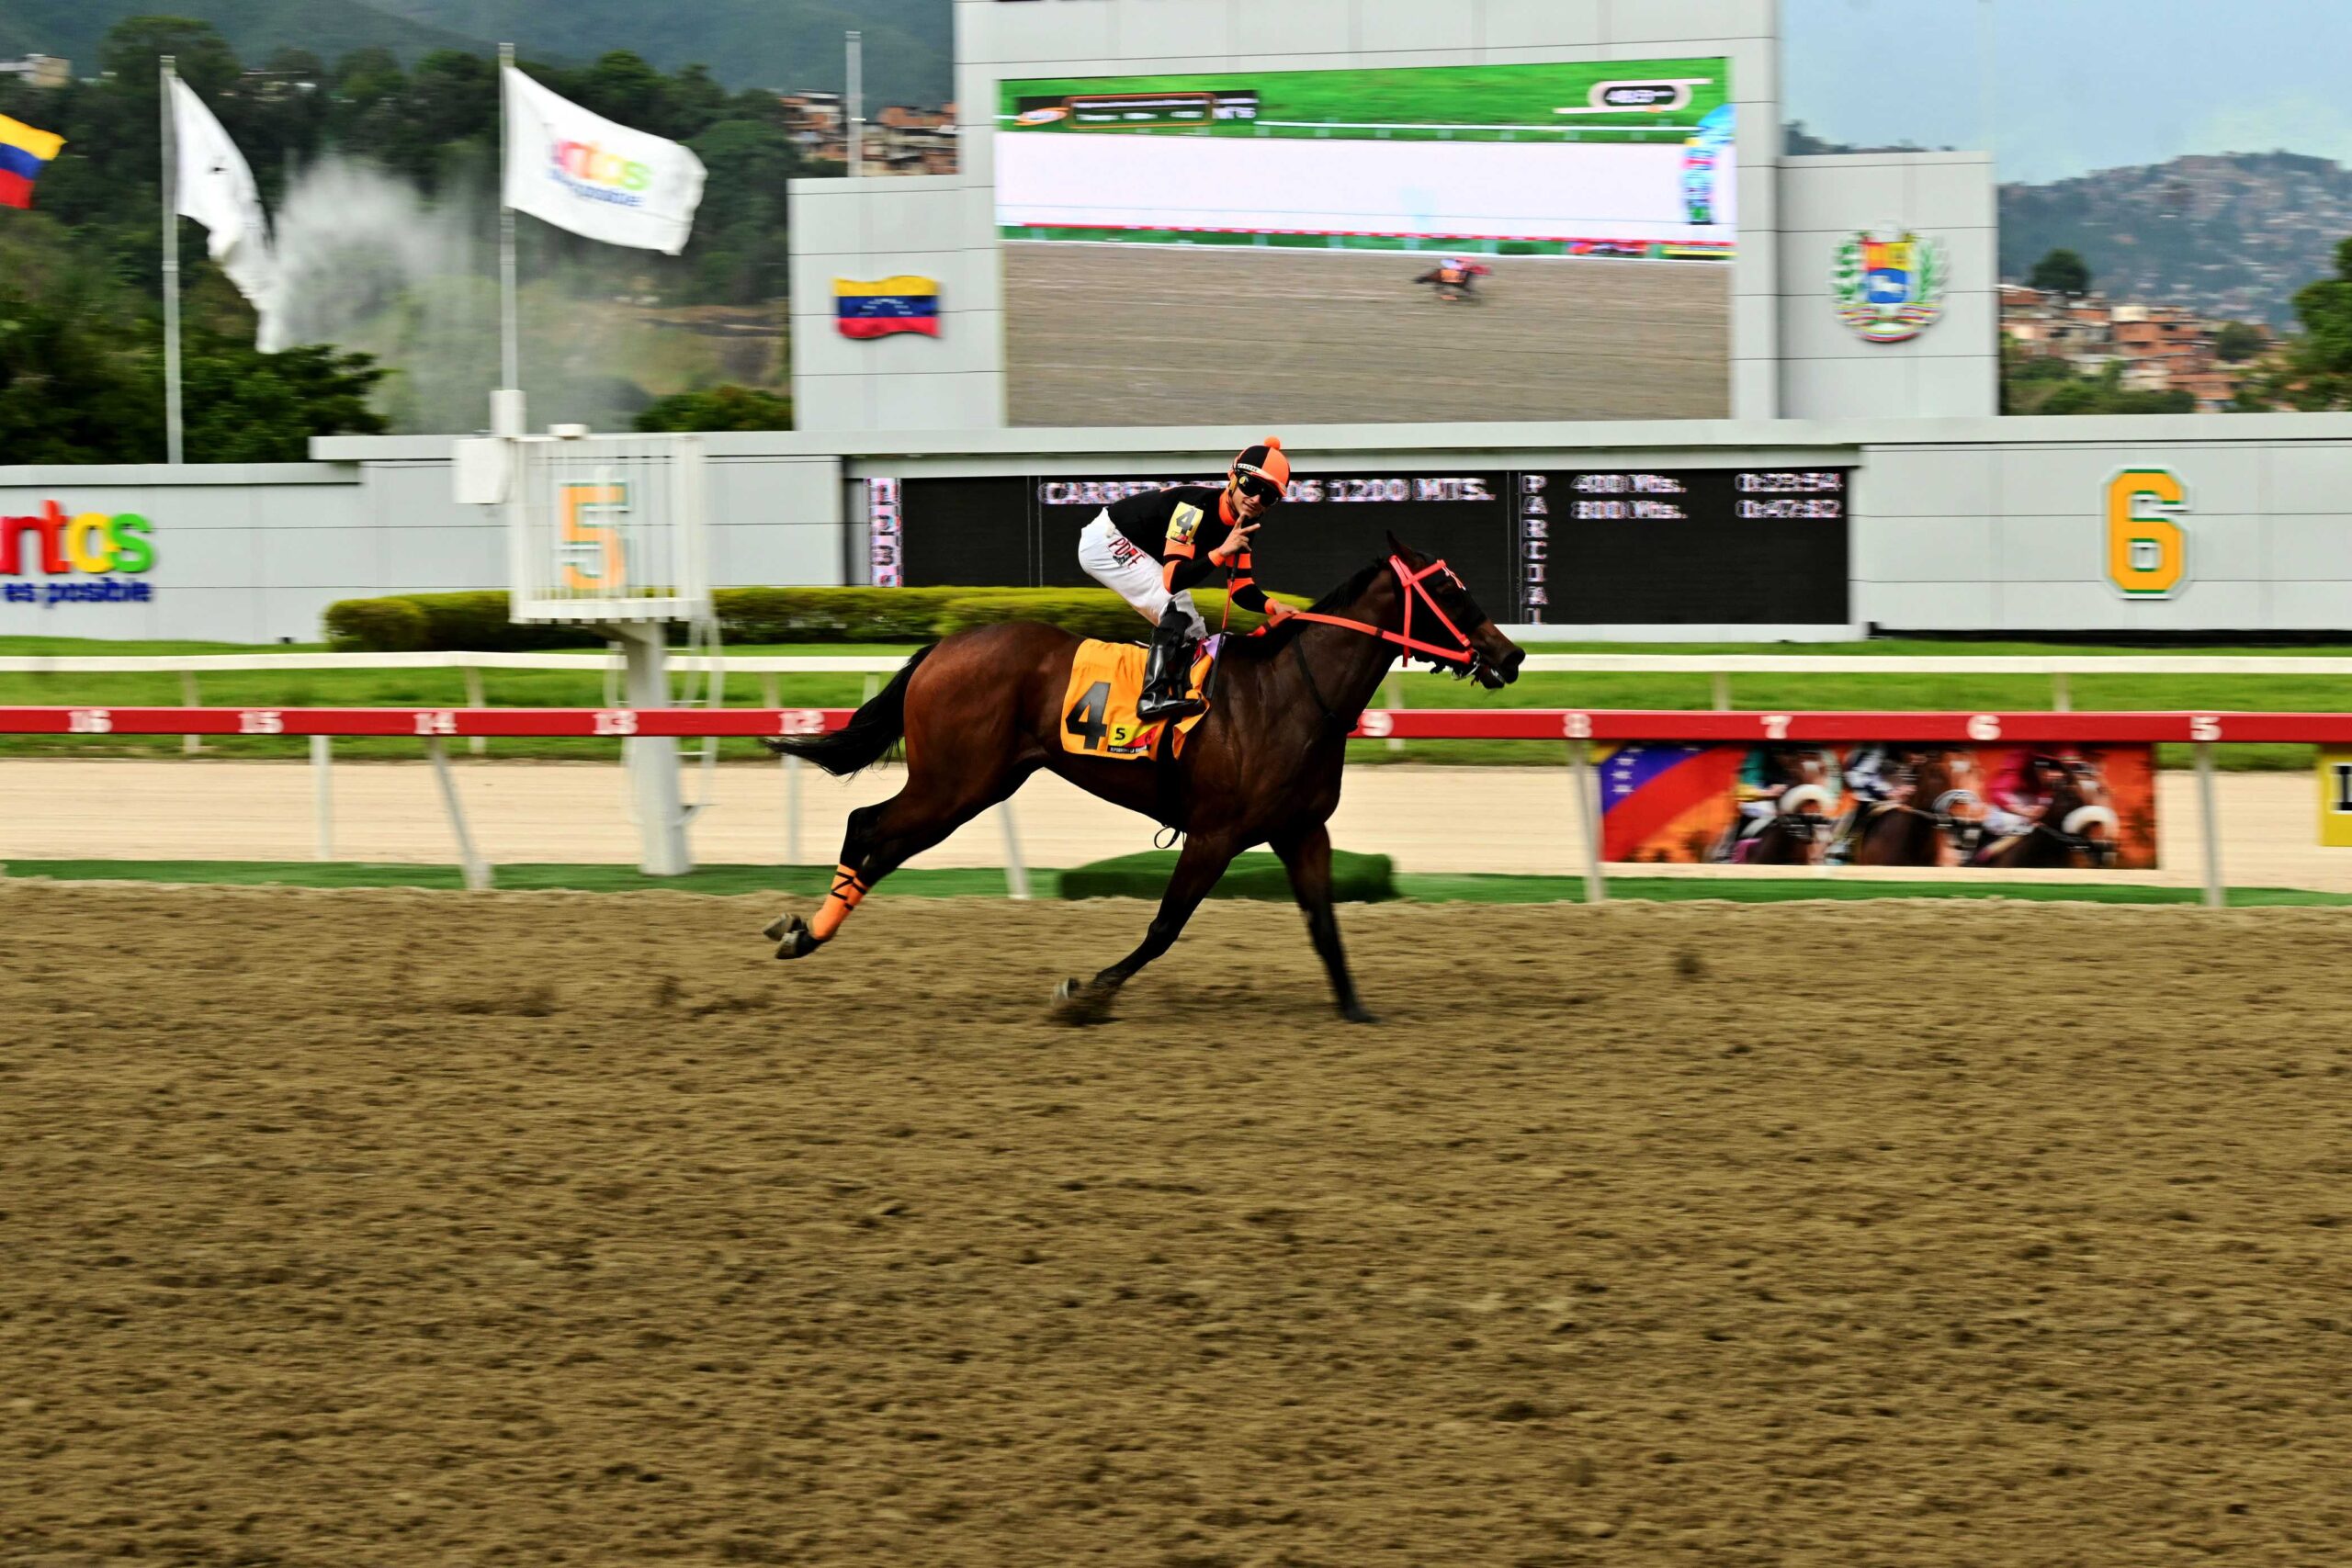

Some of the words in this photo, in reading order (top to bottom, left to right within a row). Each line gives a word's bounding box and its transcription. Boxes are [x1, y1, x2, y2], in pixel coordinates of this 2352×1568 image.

[1327, 479, 1411, 502] 1200
[1570, 474, 1625, 493] 400
[1176, 506, 1197, 536] 4
[1570, 500, 1625, 519] 800
[559, 479, 632, 591] 5
[2103, 467, 2189, 596] 6
[4, 581, 36, 603] es
[46, 576, 153, 609] posible
[67, 709, 113, 734] 16
[237, 711, 285, 734] 15
[413, 711, 458, 735] 14
[593, 711, 639, 735] 13
[778, 710, 825, 735] 12
[1066, 681, 1112, 750] 4
[1359, 711, 1394, 737] 9
[1563, 713, 1592, 738] 8
[1758, 715, 1792, 739] 7
[1966, 715, 2002, 740] 6
[1114, 727, 1126, 741] 5
[2190, 716, 2222, 741] 5
